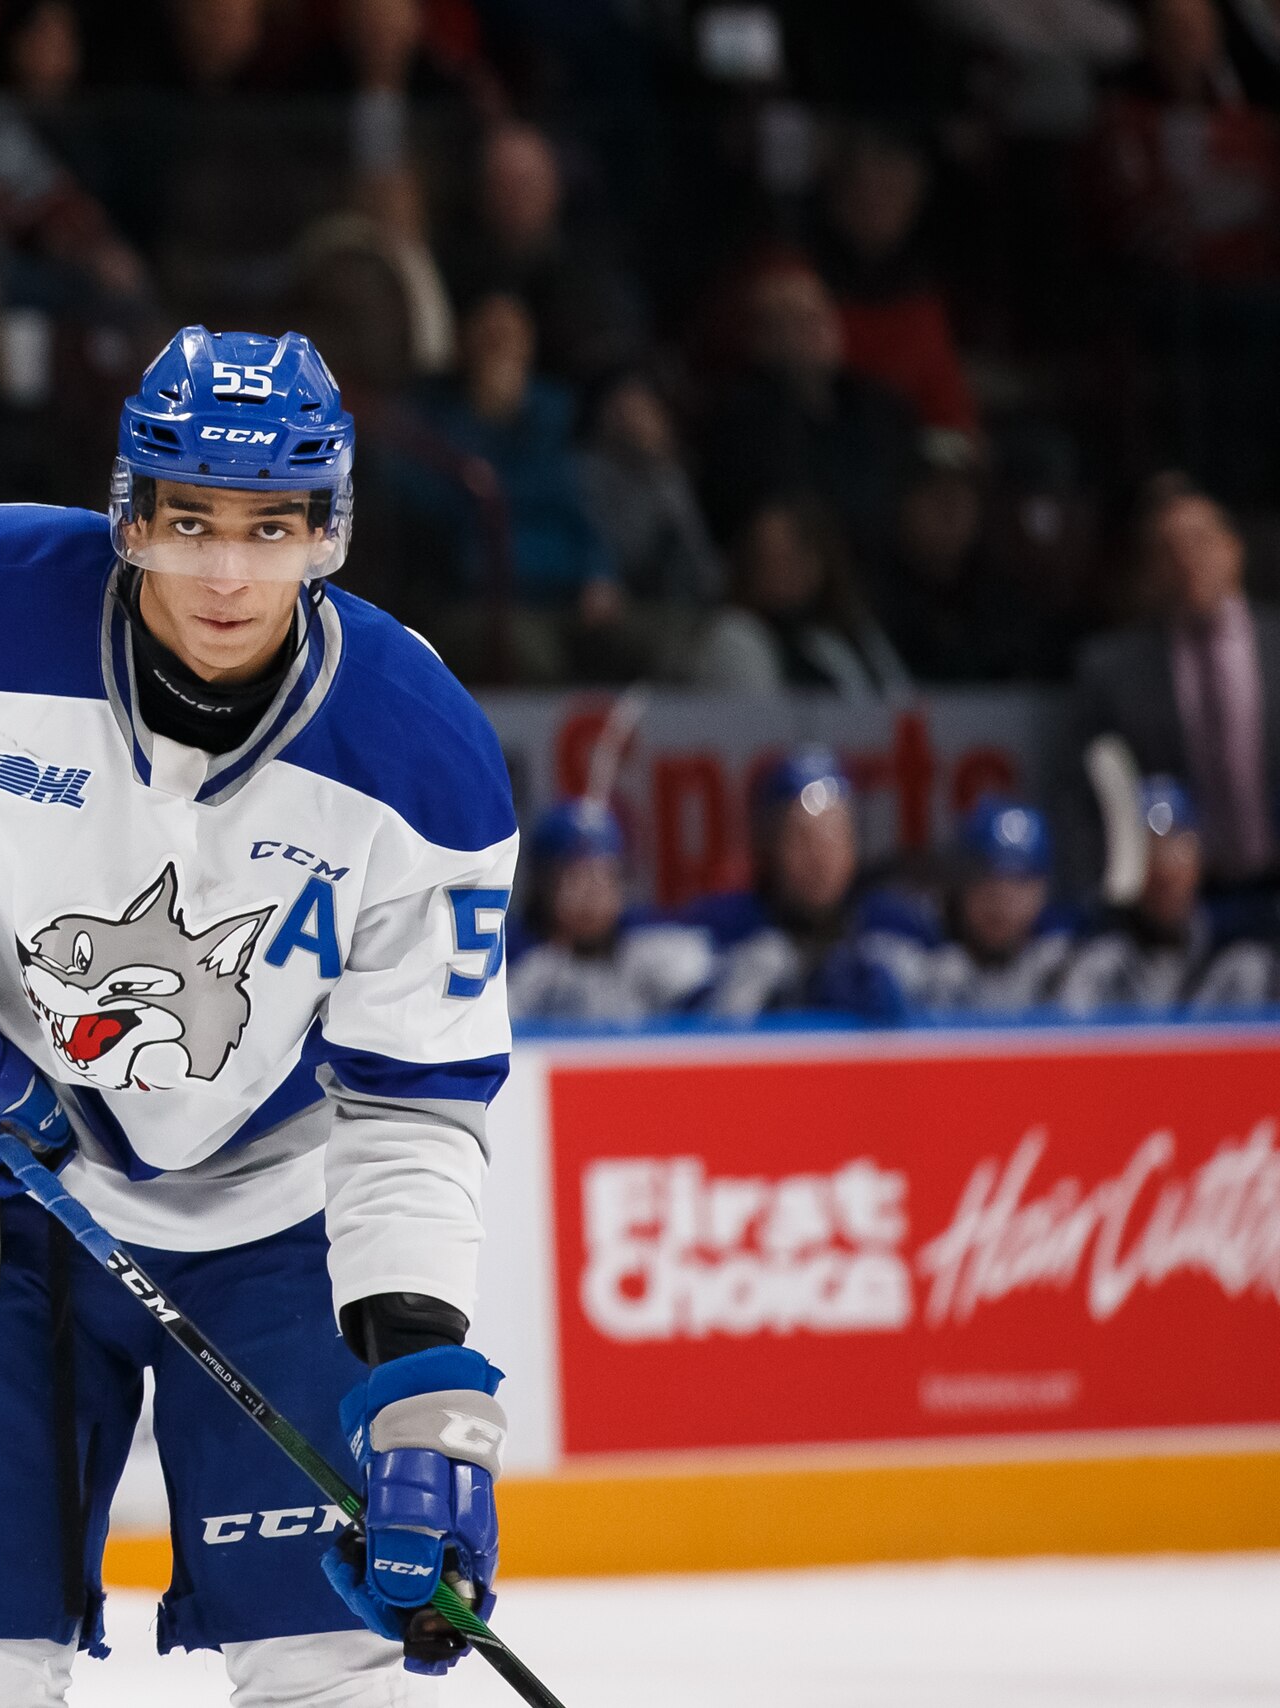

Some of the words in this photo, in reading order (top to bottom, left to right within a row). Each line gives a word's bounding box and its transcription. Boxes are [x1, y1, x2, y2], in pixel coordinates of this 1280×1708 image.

[212, 361, 273, 398] 55
[200, 426, 277, 445] CCM
[250, 841, 350, 881] CCM
[264, 874, 344, 980] A
[581, 1153, 910, 1256] First
[581, 1250, 913, 1342] Choice
[200, 1350, 232, 1382] BYFIELD
[230, 1380, 242, 1392] 55
[373, 1558, 434, 1577] CCM
